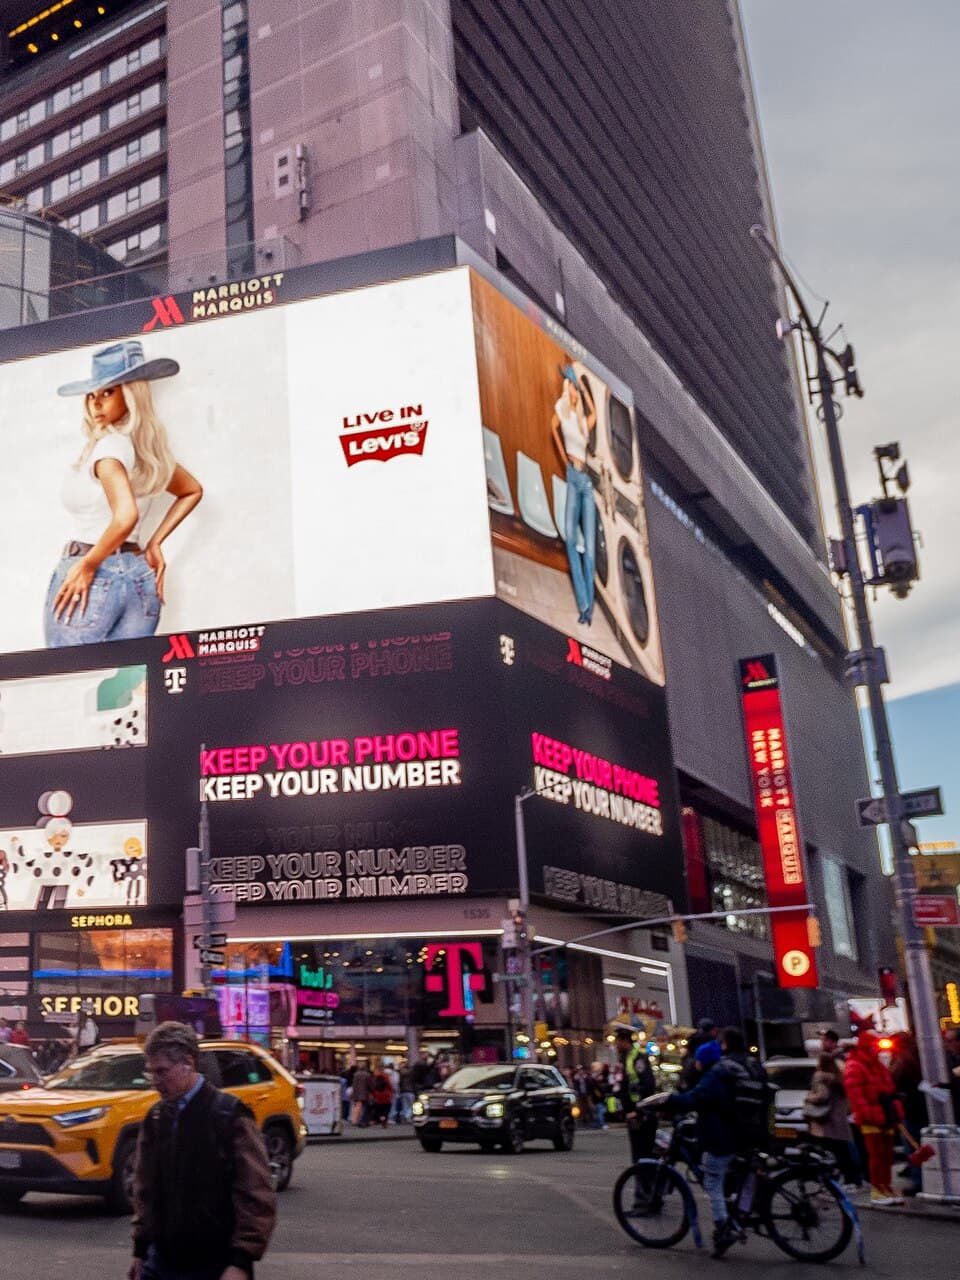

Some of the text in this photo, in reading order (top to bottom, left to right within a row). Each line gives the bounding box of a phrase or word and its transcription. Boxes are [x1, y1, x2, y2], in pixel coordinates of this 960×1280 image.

[193, 273, 283, 303] MARRIOTT
[193, 291, 273, 318] MARQUIS
[400, 404, 423, 419] IN
[198, 638, 258, 654] MARQUIS
[199, 626, 266, 643] MARRIOTT
[268, 655, 346, 687] YOUR
[351, 645, 452, 679] PHONE
[201, 728, 460, 776] KEEP YOUR PHONE
[531, 731, 661, 808] KEEP YOUR PHONE
[751, 730, 774, 808] NEW YORK
[767, 728, 790, 807] MARRIOTT
[200, 759, 461, 802] KEEP YOUR NUMBER
[533, 765, 664, 837] KEEP YOUR NUMBER
[208, 843, 468, 883] KEEP YOUR NUMBER
[71, 914, 133, 928] SEPHORA
[425, 942, 485, 1017] T
